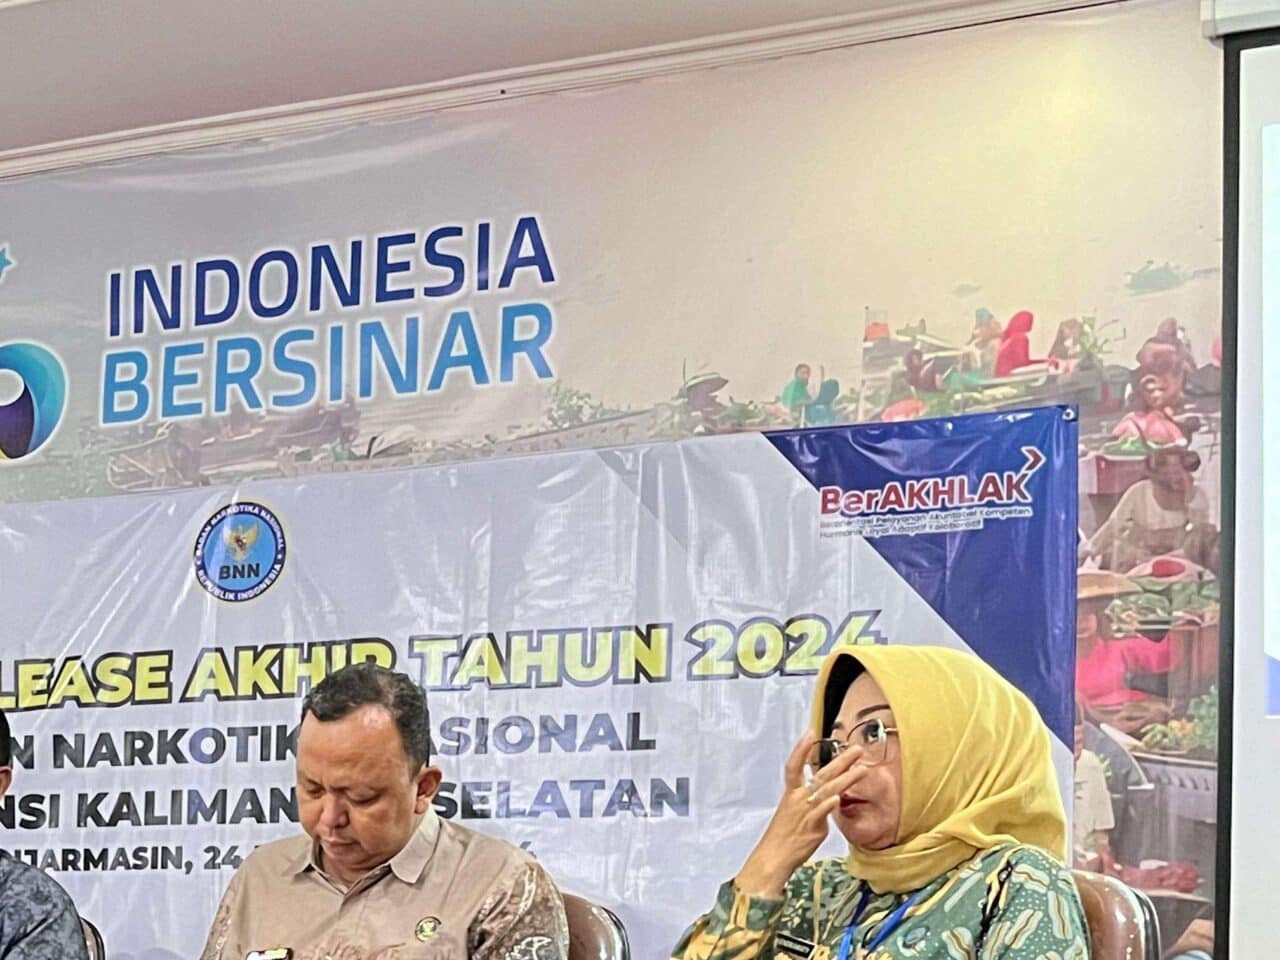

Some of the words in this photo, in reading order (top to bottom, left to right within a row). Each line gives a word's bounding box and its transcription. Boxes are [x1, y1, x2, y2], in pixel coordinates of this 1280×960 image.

[110, 216, 555, 337] INDONESIA
[101, 303, 554, 424] BERSINAR
[820, 471, 1032, 516] BerAKHLAK
[219, 563, 260, 580] BNN
[408, 622, 672, 691] TAHUN
[53, 723, 300, 770] NARKOTIK
[429, 712, 657, 756] SIONAL
[77, 786, 300, 829] KALIMAN
[432, 777, 690, 820] SELATAN
[203, 845, 243, 870] 24
